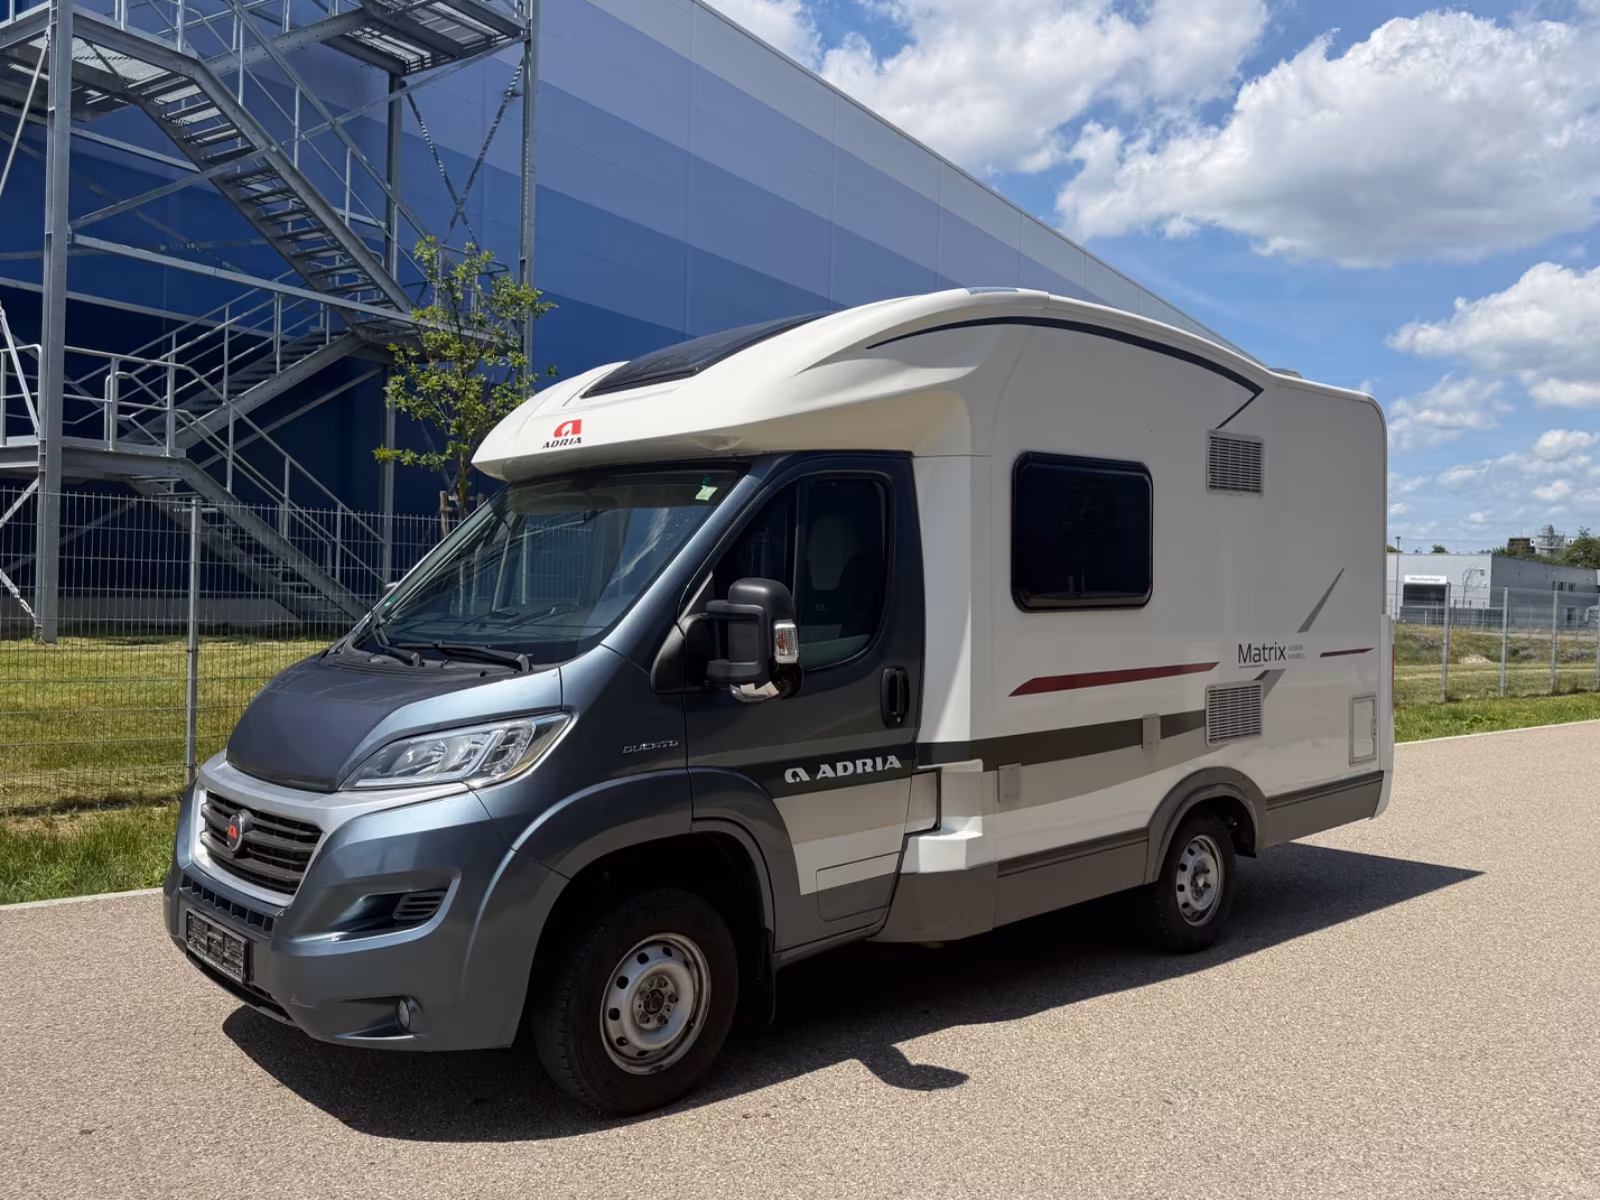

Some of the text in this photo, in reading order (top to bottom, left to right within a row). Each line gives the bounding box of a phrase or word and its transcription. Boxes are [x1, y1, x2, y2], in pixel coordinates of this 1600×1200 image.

[541, 437, 582, 449] ADRIA
[1238, 642, 1286, 663] Matrix
[816, 755, 903, 780] ADRIA
